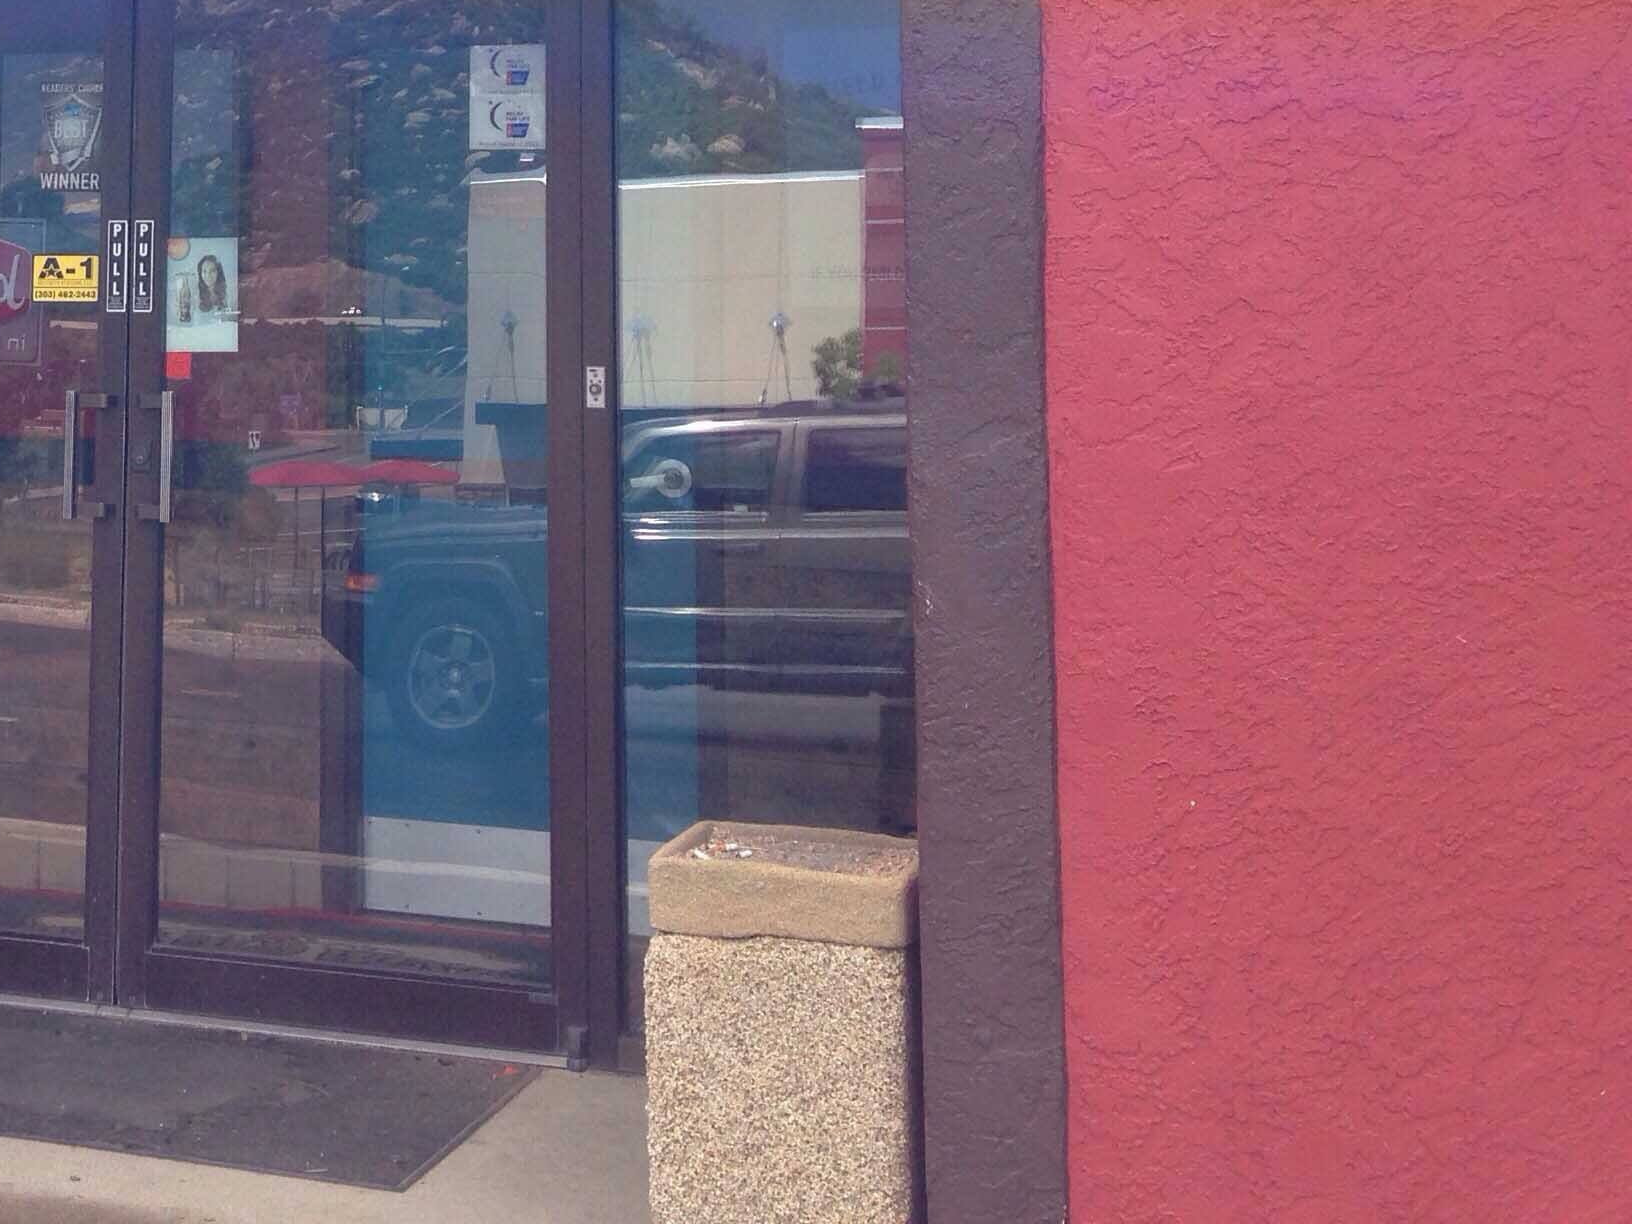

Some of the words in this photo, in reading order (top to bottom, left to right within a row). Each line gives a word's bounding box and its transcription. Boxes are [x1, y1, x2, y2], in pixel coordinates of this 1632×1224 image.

[54, 119, 88, 138] BEST
[40, 172, 100, 190] WINNER
[39, 257, 93, 279] A-1
[112, 223, 122, 296] PULL
[138, 223, 149, 296] PULL
